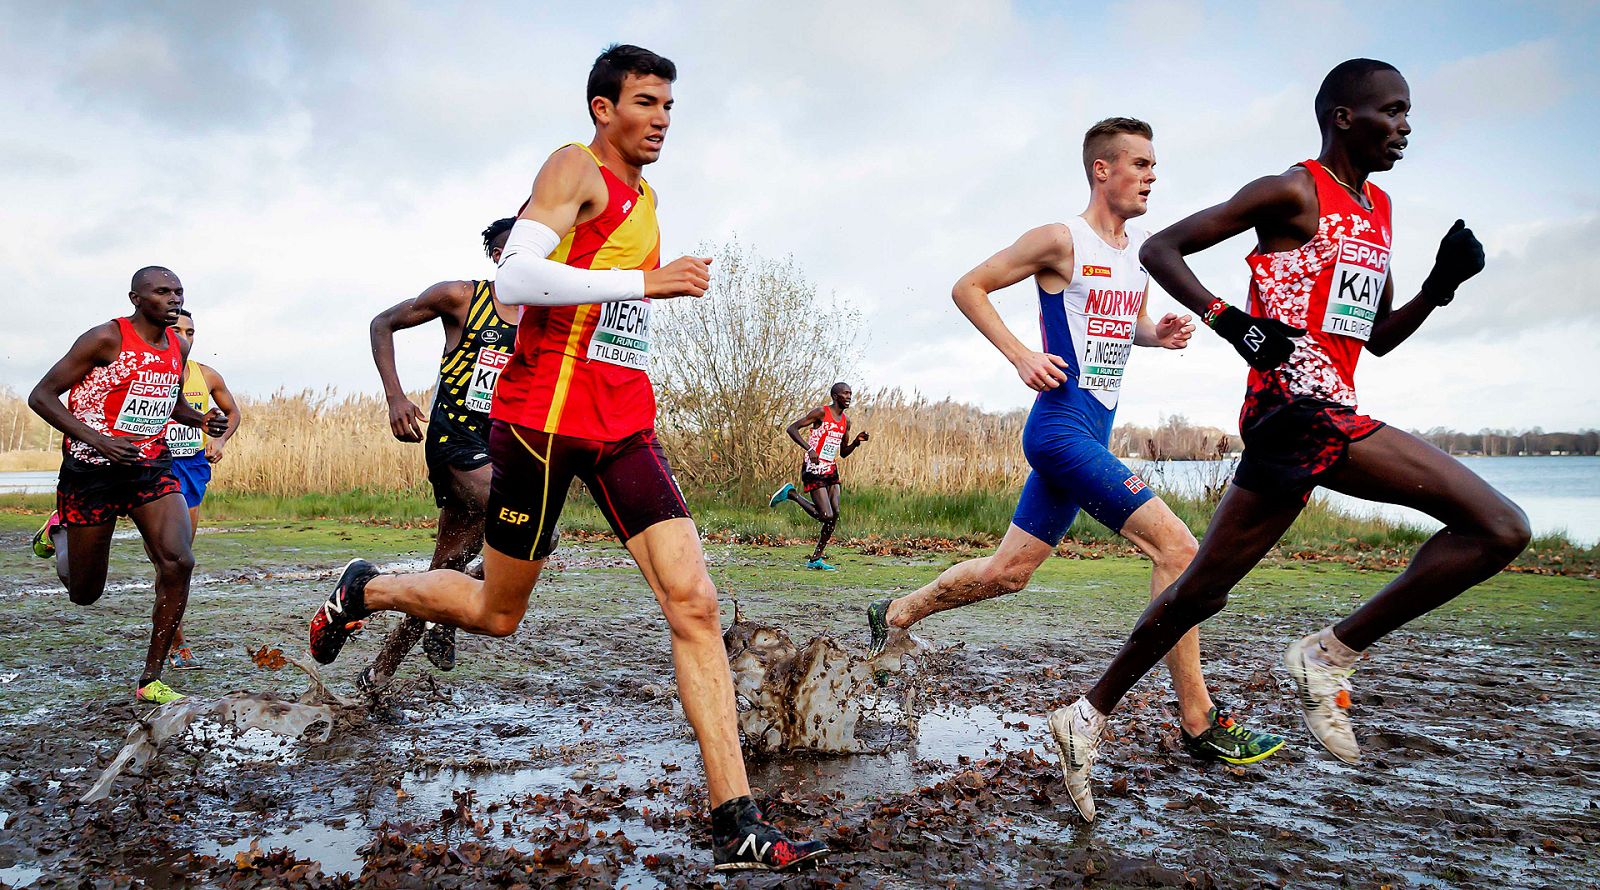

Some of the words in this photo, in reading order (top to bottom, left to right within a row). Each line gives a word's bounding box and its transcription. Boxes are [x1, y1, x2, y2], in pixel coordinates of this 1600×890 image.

[1341, 243, 1388, 271] SPAR
[1084, 288, 1143, 316] NORWA
[481, 351, 508, 366] SP
[1084, 340, 1092, 362] F.
[475, 369, 497, 390] KI
[130, 383, 170, 397] SPAR
[471, 399, 491, 411] TILB
[499, 506, 530, 525] ESP
